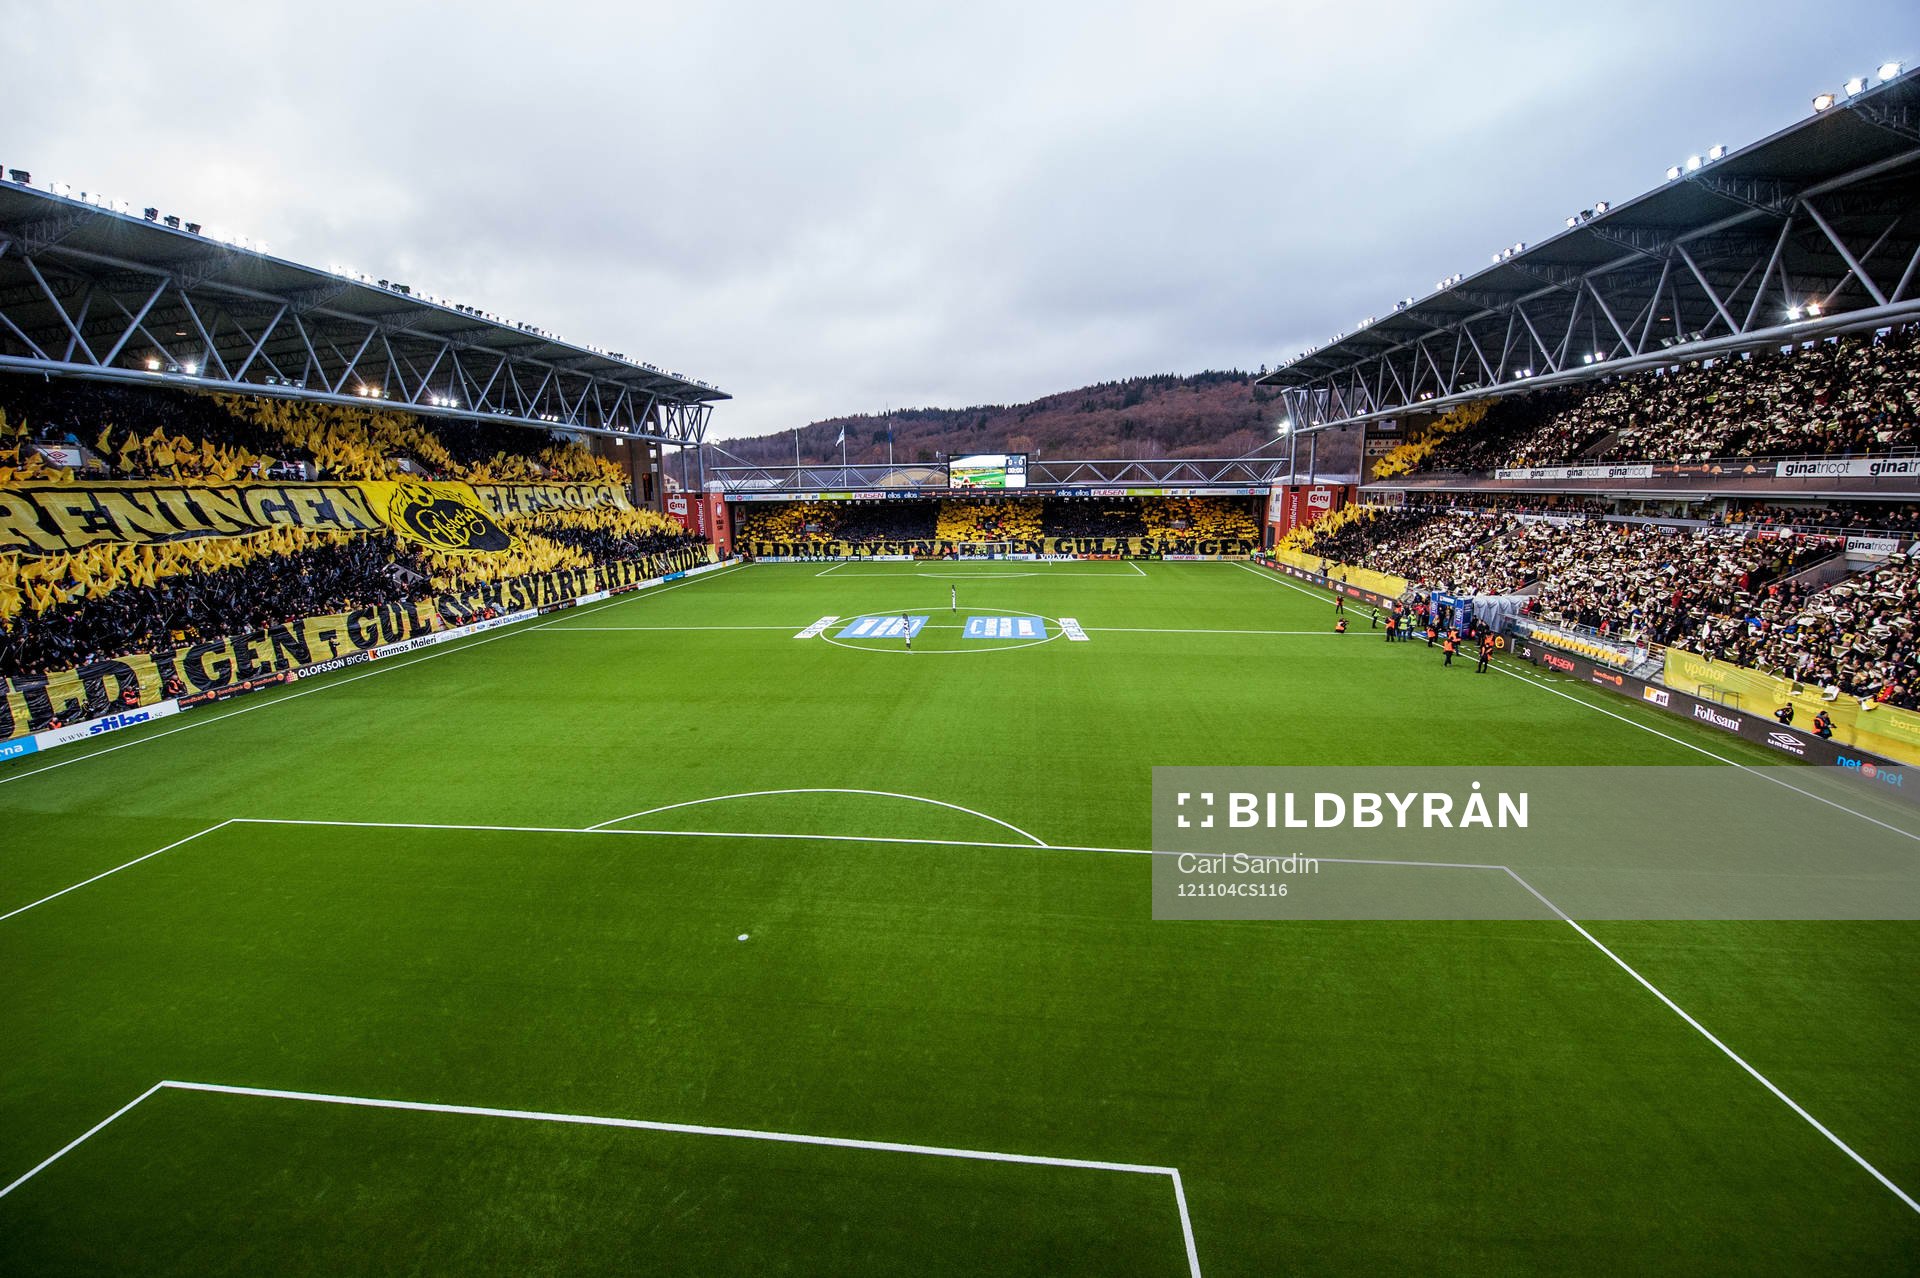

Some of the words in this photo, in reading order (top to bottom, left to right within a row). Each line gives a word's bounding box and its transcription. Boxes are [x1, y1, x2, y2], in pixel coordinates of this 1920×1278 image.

[372, 642, 409, 659] Kimmos
[298, 659, 345, 678] OLOFSSON
[346, 653, 369, 666] BYGG
[1694, 704, 1739, 731] Folksam
